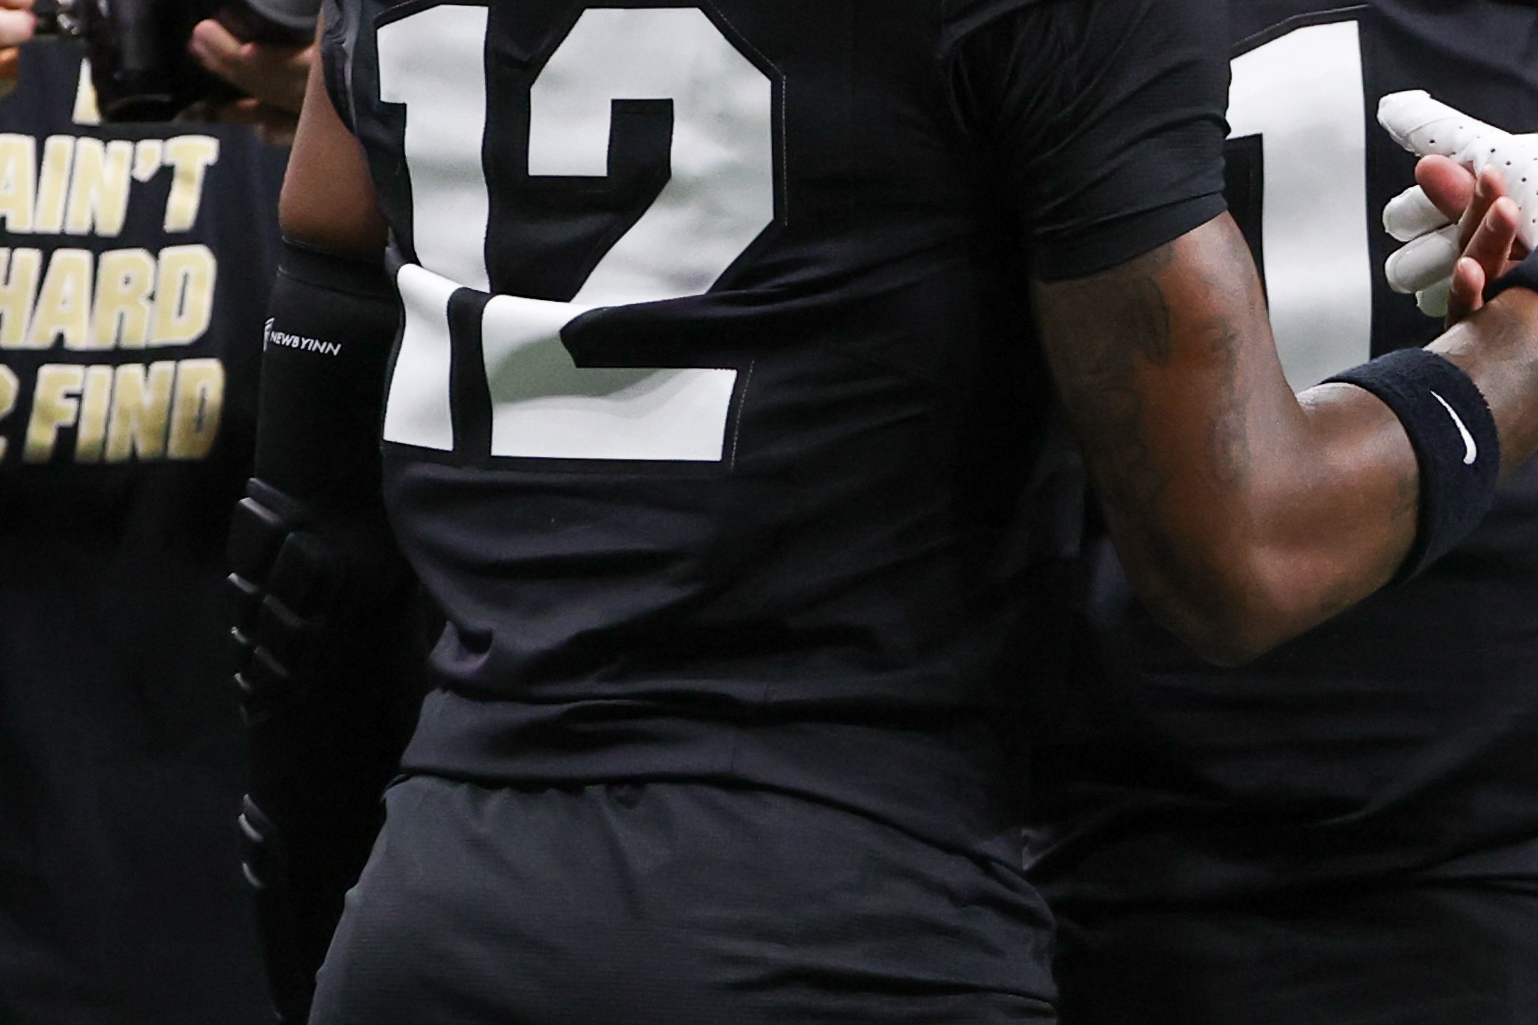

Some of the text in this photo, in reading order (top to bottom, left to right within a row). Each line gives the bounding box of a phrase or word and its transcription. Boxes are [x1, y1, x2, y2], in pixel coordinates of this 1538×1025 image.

[376, 4, 775, 462] 12
[0, 244, 217, 351] HARD
[23, 358, 226, 465] FIND
